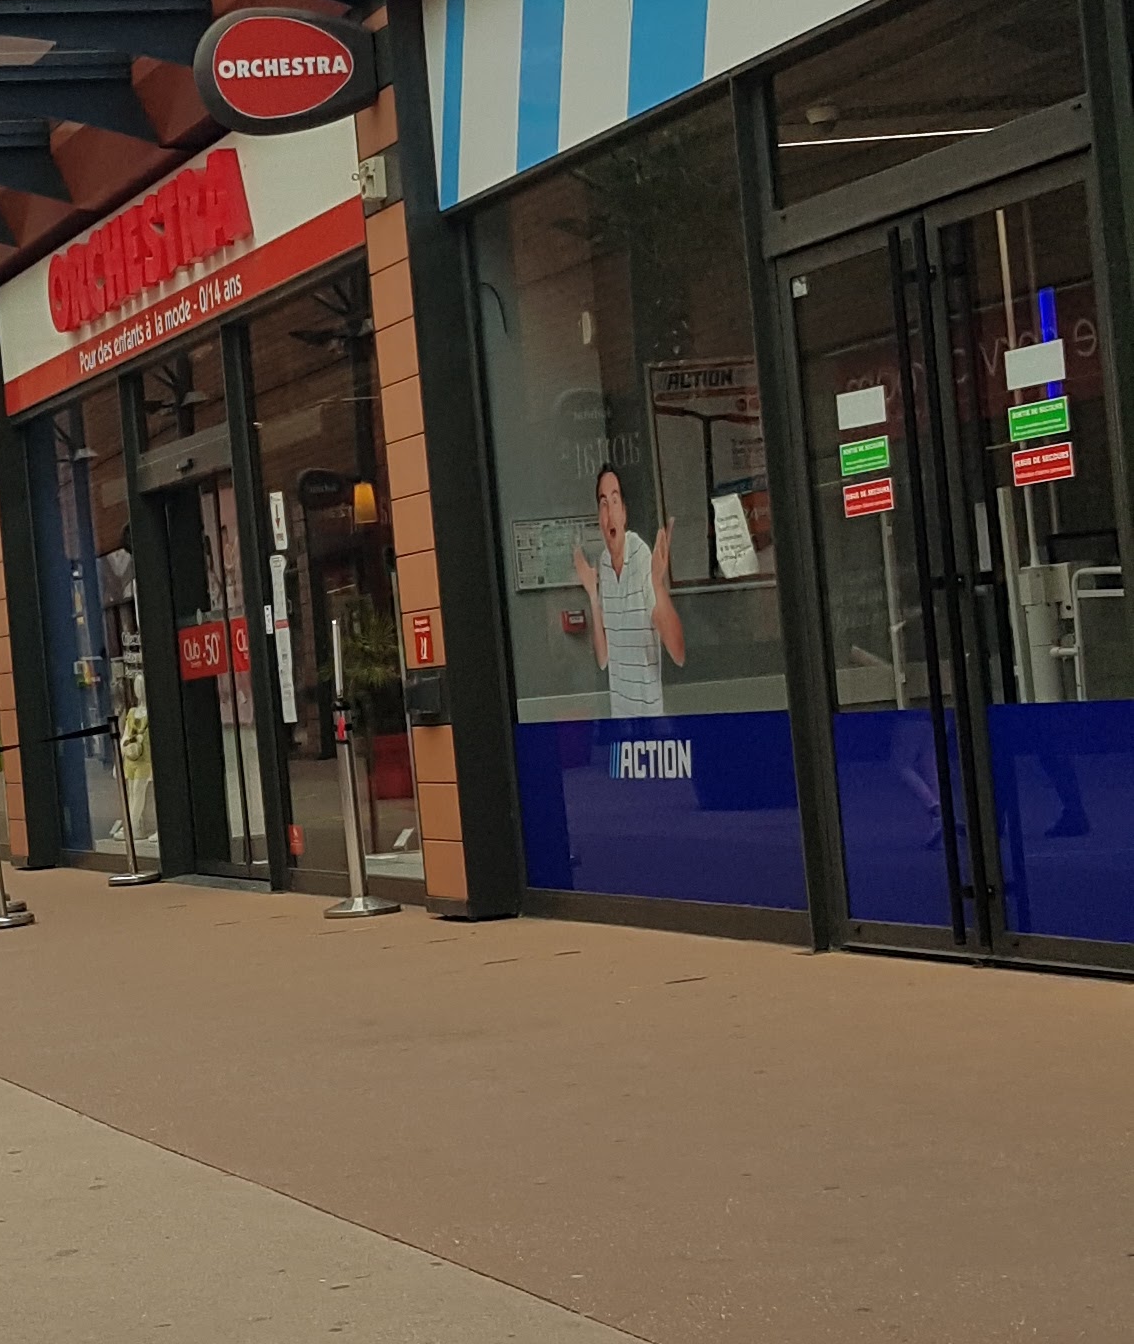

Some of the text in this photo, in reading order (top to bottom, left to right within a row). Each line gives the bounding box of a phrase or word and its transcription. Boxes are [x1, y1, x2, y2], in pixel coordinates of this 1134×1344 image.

[218, 55, 348, 80] ORCHESTRA
[48, 148, 254, 334] ORCHESTRA
[78, 348, 98, 374] Pour
[97, 337, 113, 364] des
[113, 322, 145, 356] enfants
[153, 310, 164, 337] la
[164, 296, 192, 330] mode
[198, 277, 221, 314] 0/14
[223, 273, 243, 302] ans
[667, 368, 733, 390] ACTION
[183, 637, 200, 662] Club
[620, 740, 691, 779] ACTION
